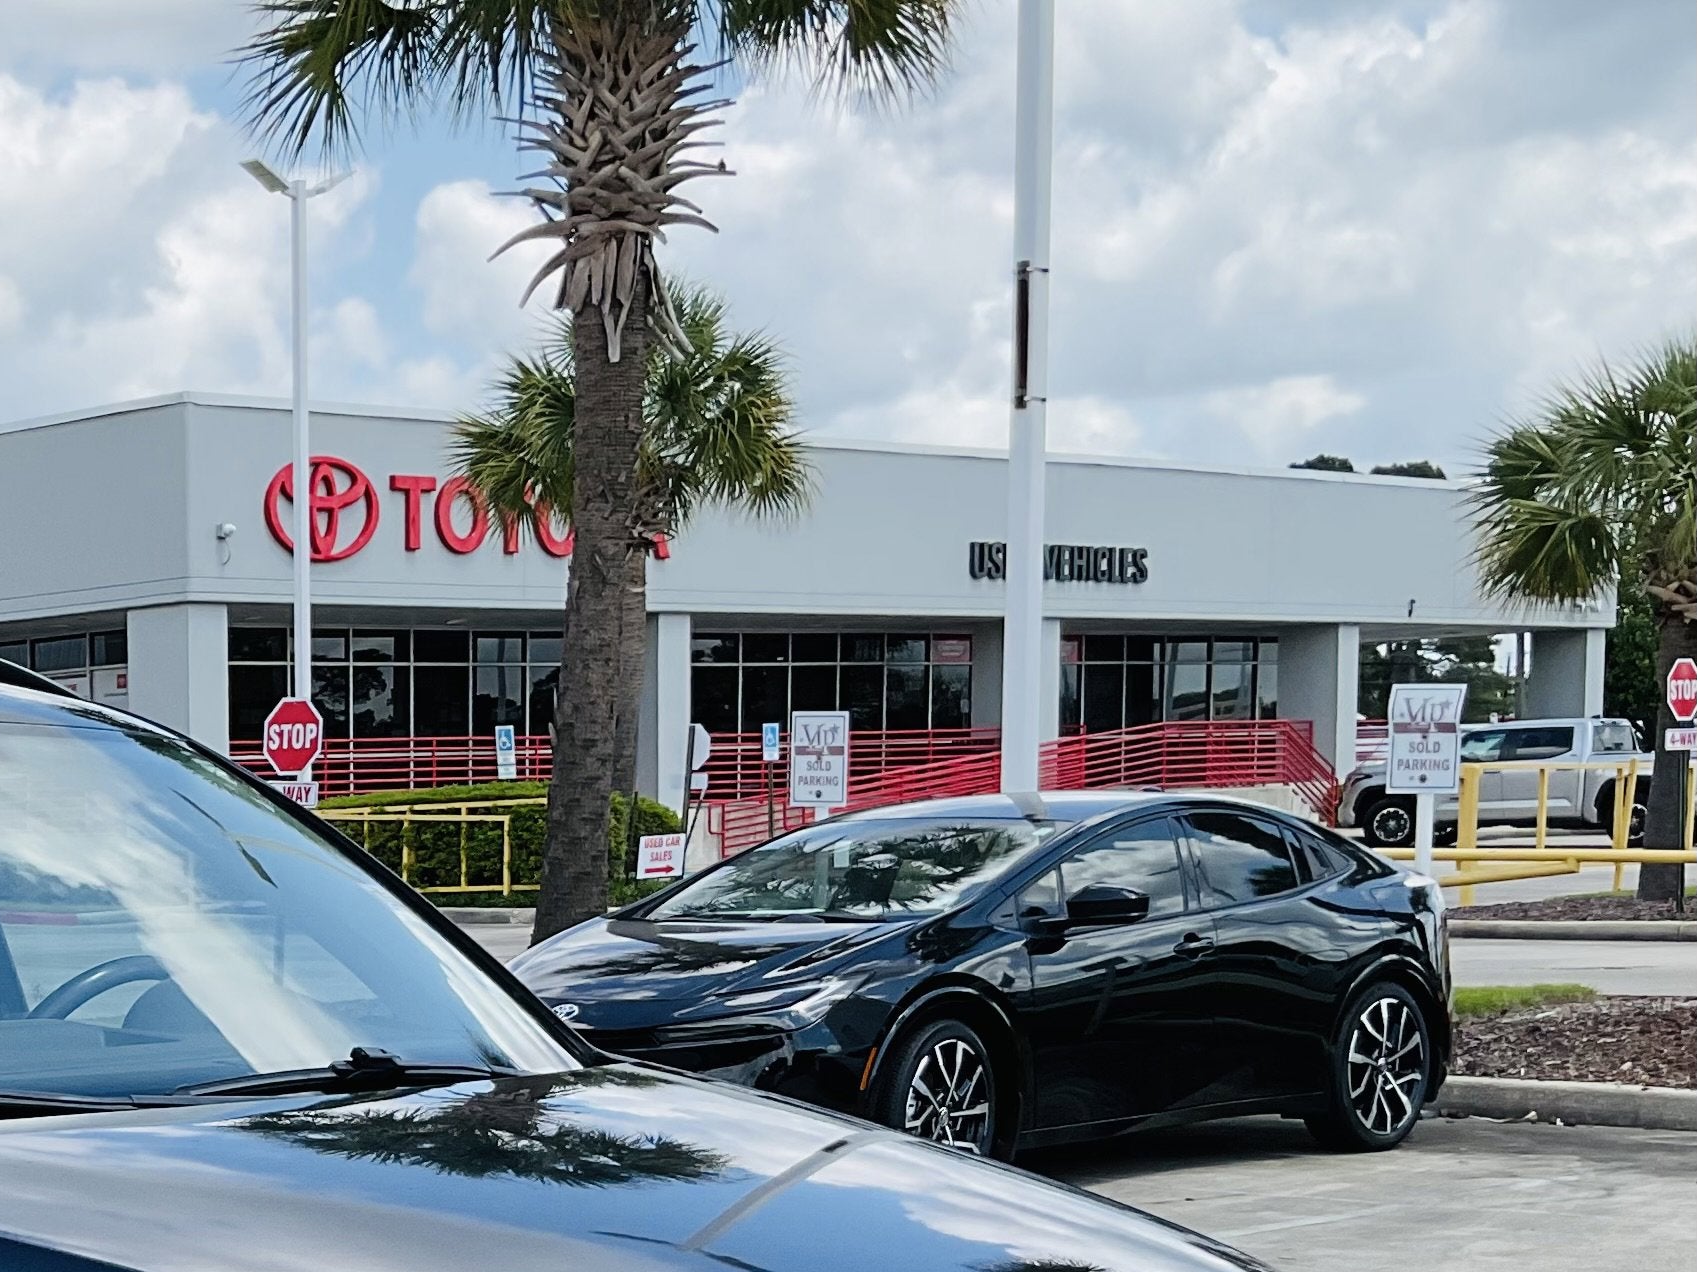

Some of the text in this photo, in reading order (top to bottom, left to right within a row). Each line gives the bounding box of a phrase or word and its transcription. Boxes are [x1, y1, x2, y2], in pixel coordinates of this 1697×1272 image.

[1042, 543, 1148, 584] VEHICLES
[1670, 679, 1697, 701] STOP
[268, 723, 318, 751] STOP
[1409, 741, 1441, 754] SOLD
[806, 760, 832, 772] SOLD
[1397, 759, 1450, 771] PARKING
[798, 775, 839, 787] PARKING
[645, 836, 680, 848] USED CAR
[649, 851, 673, 862] SALES
